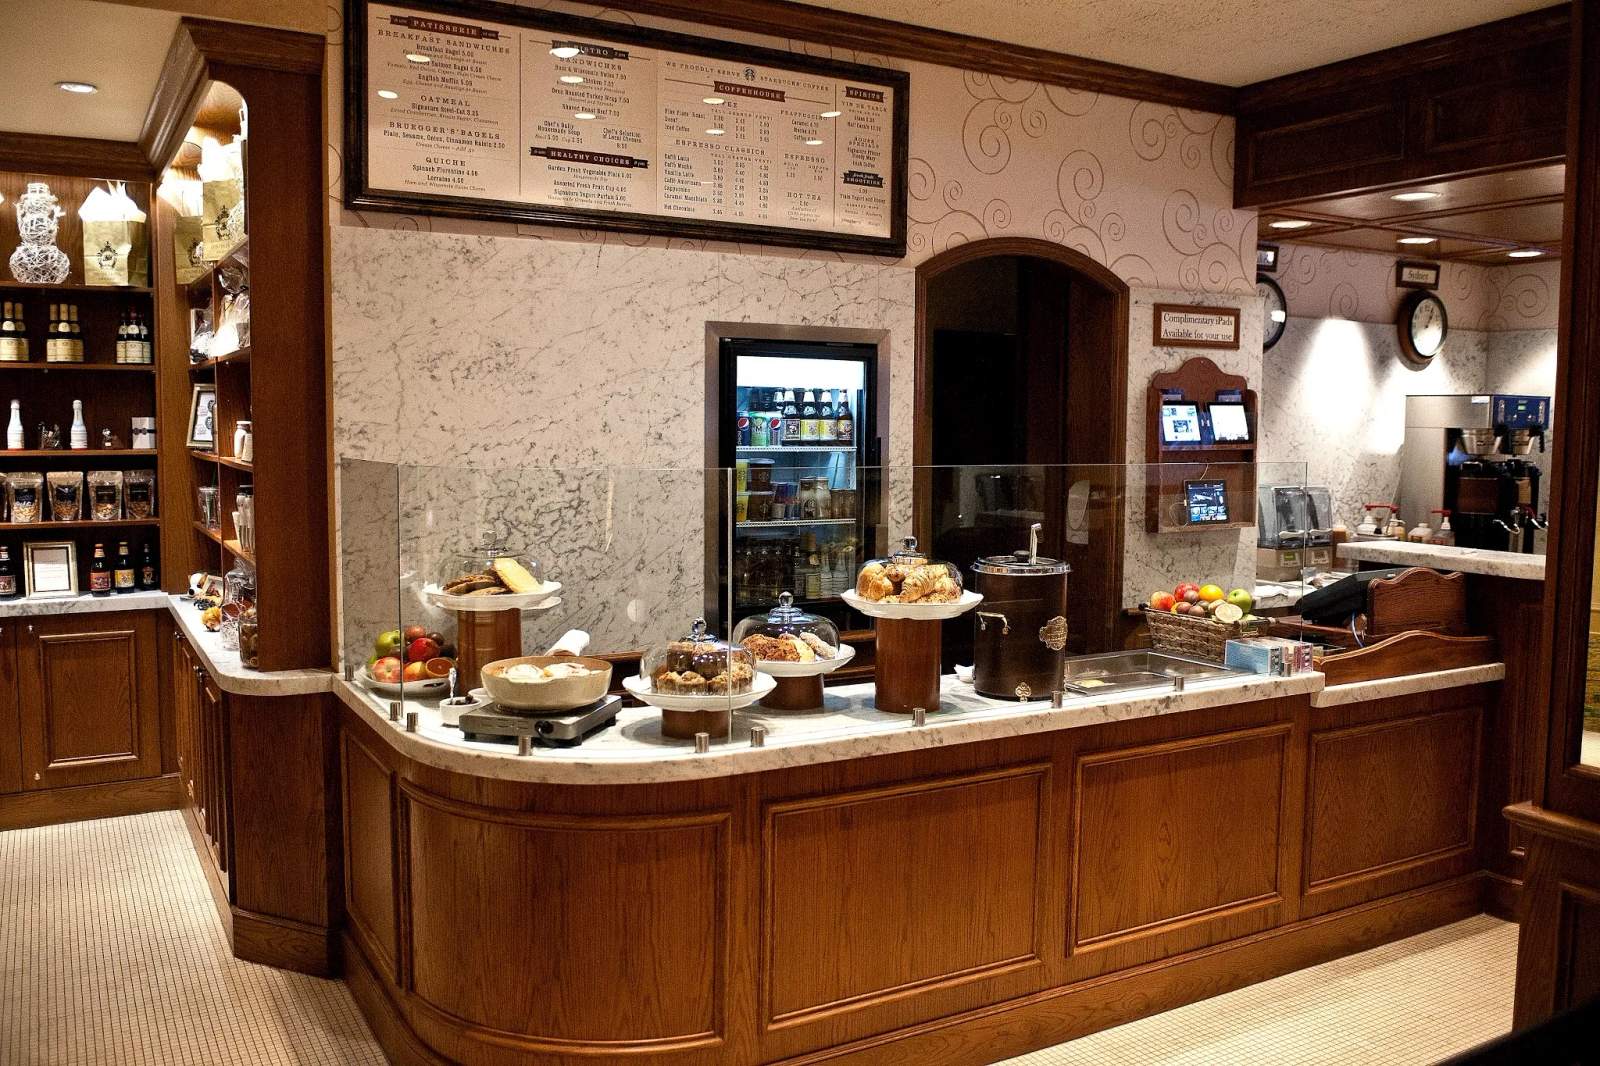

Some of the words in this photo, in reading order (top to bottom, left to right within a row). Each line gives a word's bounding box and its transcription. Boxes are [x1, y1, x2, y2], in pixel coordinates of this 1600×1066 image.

[414, 20, 477, 36] PATISSERIE
[378, 29, 441, 44] BREAKFAST
[447, 40, 510, 55] SANDWICHES
[417, 44, 443, 53] Breakfast
[446, 48, 460, 56] Bagel
[454, 64, 468, 72] Bagel
[680, 64, 714, 74] PROUDLY
[717, 70, 740, 78] SERVE
[419, 73, 439, 82] English
[441, 76, 459, 84] Muffin
[719, 84, 780, 99] COFFEEHOUSE
[803, 83, 829, 92] COFFEE
[421, 95, 470, 107] OATMEAL
[565, 90, 584, 98] Roasted
[586, 93, 603, 101] Turkey
[461, 130, 500, 140] BAGELS
[446, 137, 472, 146] Cinnamon
[676, 139, 721, 150] ESPRESSO
[725, 145, 765, 156] CLASSICS
[426, 157, 466, 167] QUICHE
[551, 150, 590, 161] HEALTHY
[594, 156, 630, 165] CHOICES
[785, 153, 826, 164] ESPRESSO
[413, 164, 435, 173] Spinach
[437, 167, 465, 175] Florentine
[548, 164, 566, 172] Garden
[847, 177, 880, 185] SMOOTHIES
[1163, 312, 1215, 327] Complimentary
[1215, 317, 1233, 326] iPads
[1163, 328, 1193, 339] Available
[1194, 329, 1204, 339] for
[1205, 333, 1219, 341] your
